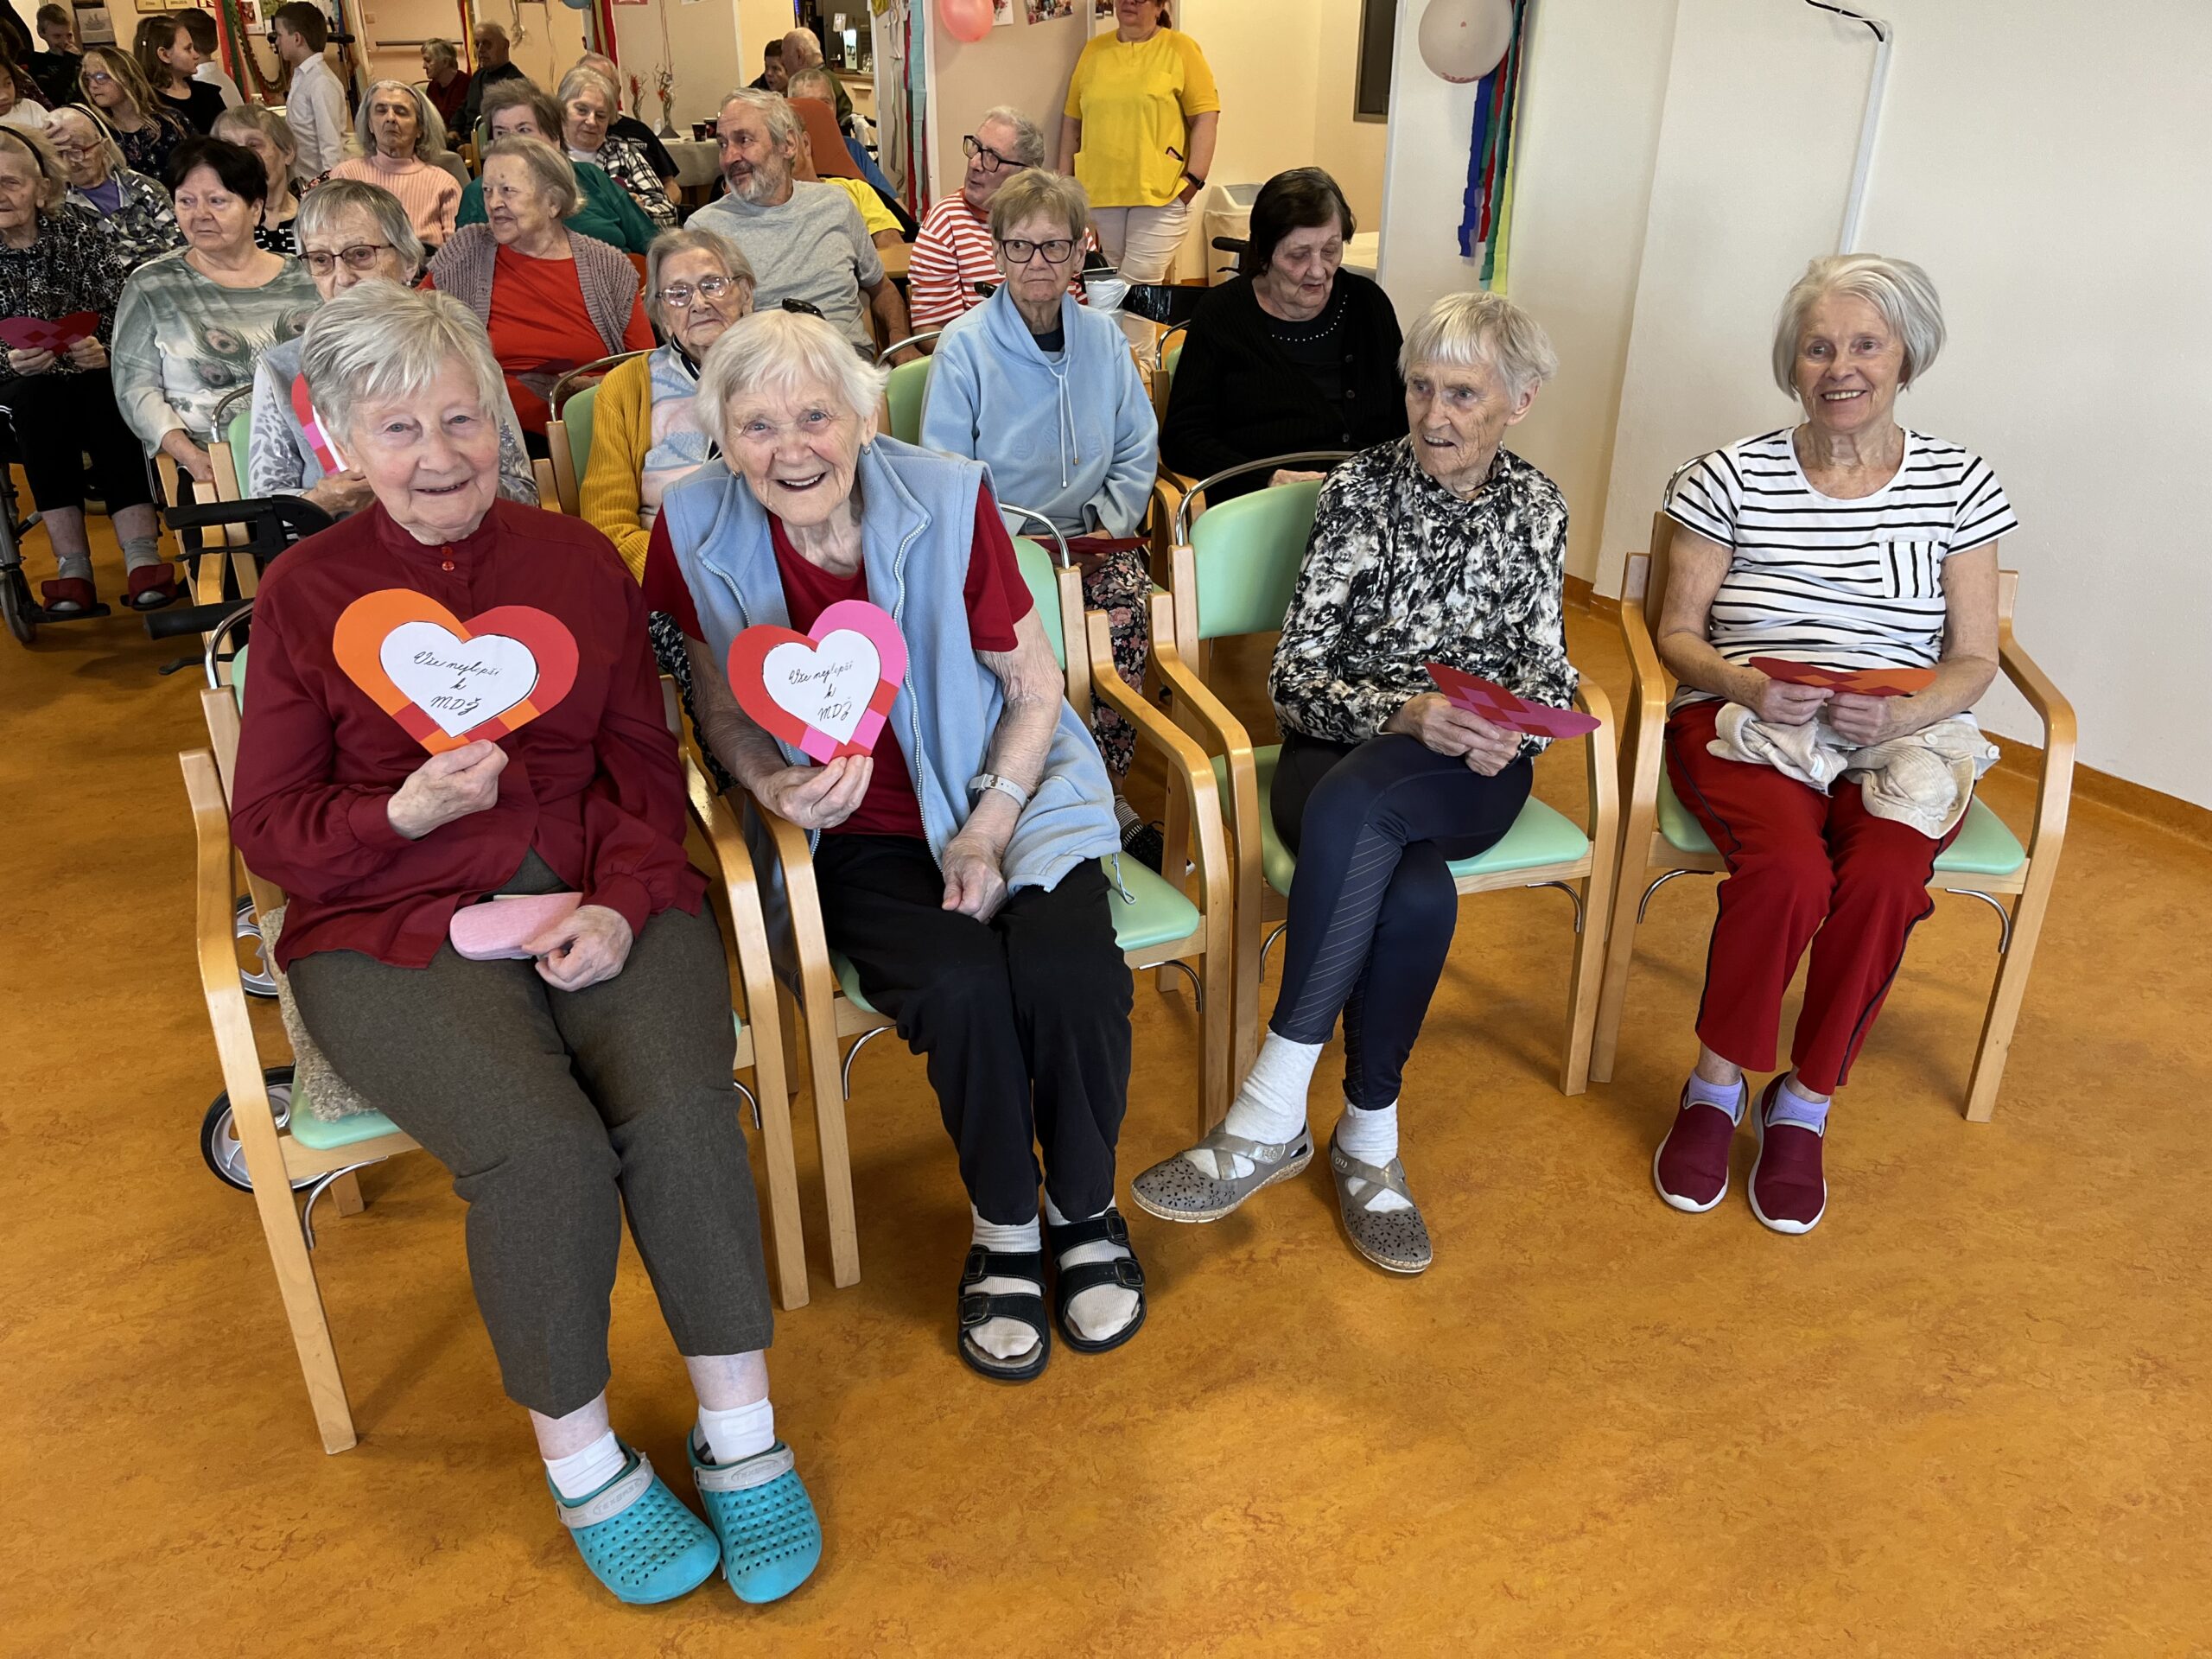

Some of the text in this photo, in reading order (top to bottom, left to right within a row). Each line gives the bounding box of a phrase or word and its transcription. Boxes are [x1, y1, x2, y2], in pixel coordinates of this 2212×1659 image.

[414, 651, 447, 666] Vše
[449, 677, 467, 690] k
[823, 683, 836, 699] k
[430, 696, 482, 716] MDŽ
[817, 696, 852, 721] MDŽ
